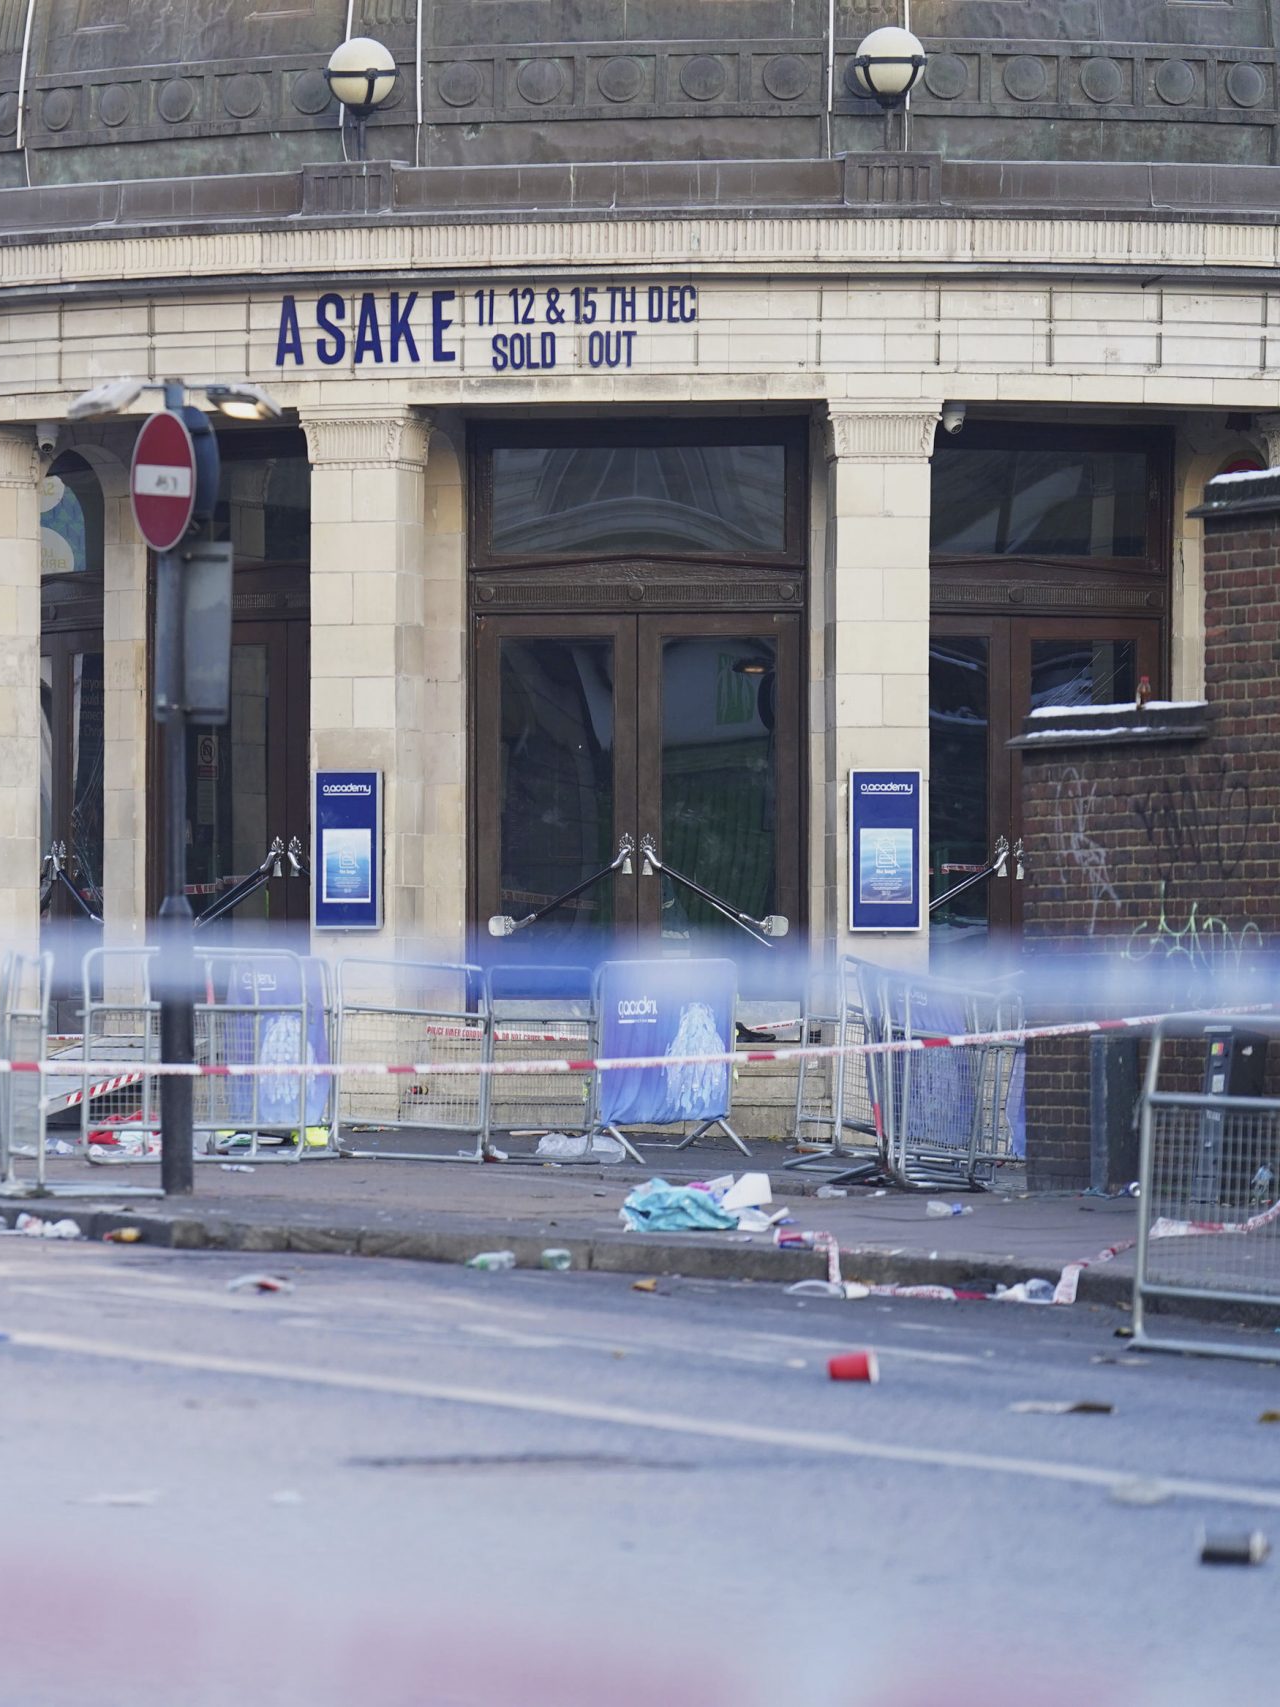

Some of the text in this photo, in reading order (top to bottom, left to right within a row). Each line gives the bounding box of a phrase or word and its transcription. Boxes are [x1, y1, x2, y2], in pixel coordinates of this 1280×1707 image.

[509, 287, 535, 325] 12
[546, 287, 565, 324] &
[648, 285, 696, 323] DEC
[276, 291, 456, 366] ASAKE
[492, 331, 637, 371] SOLD OUT
